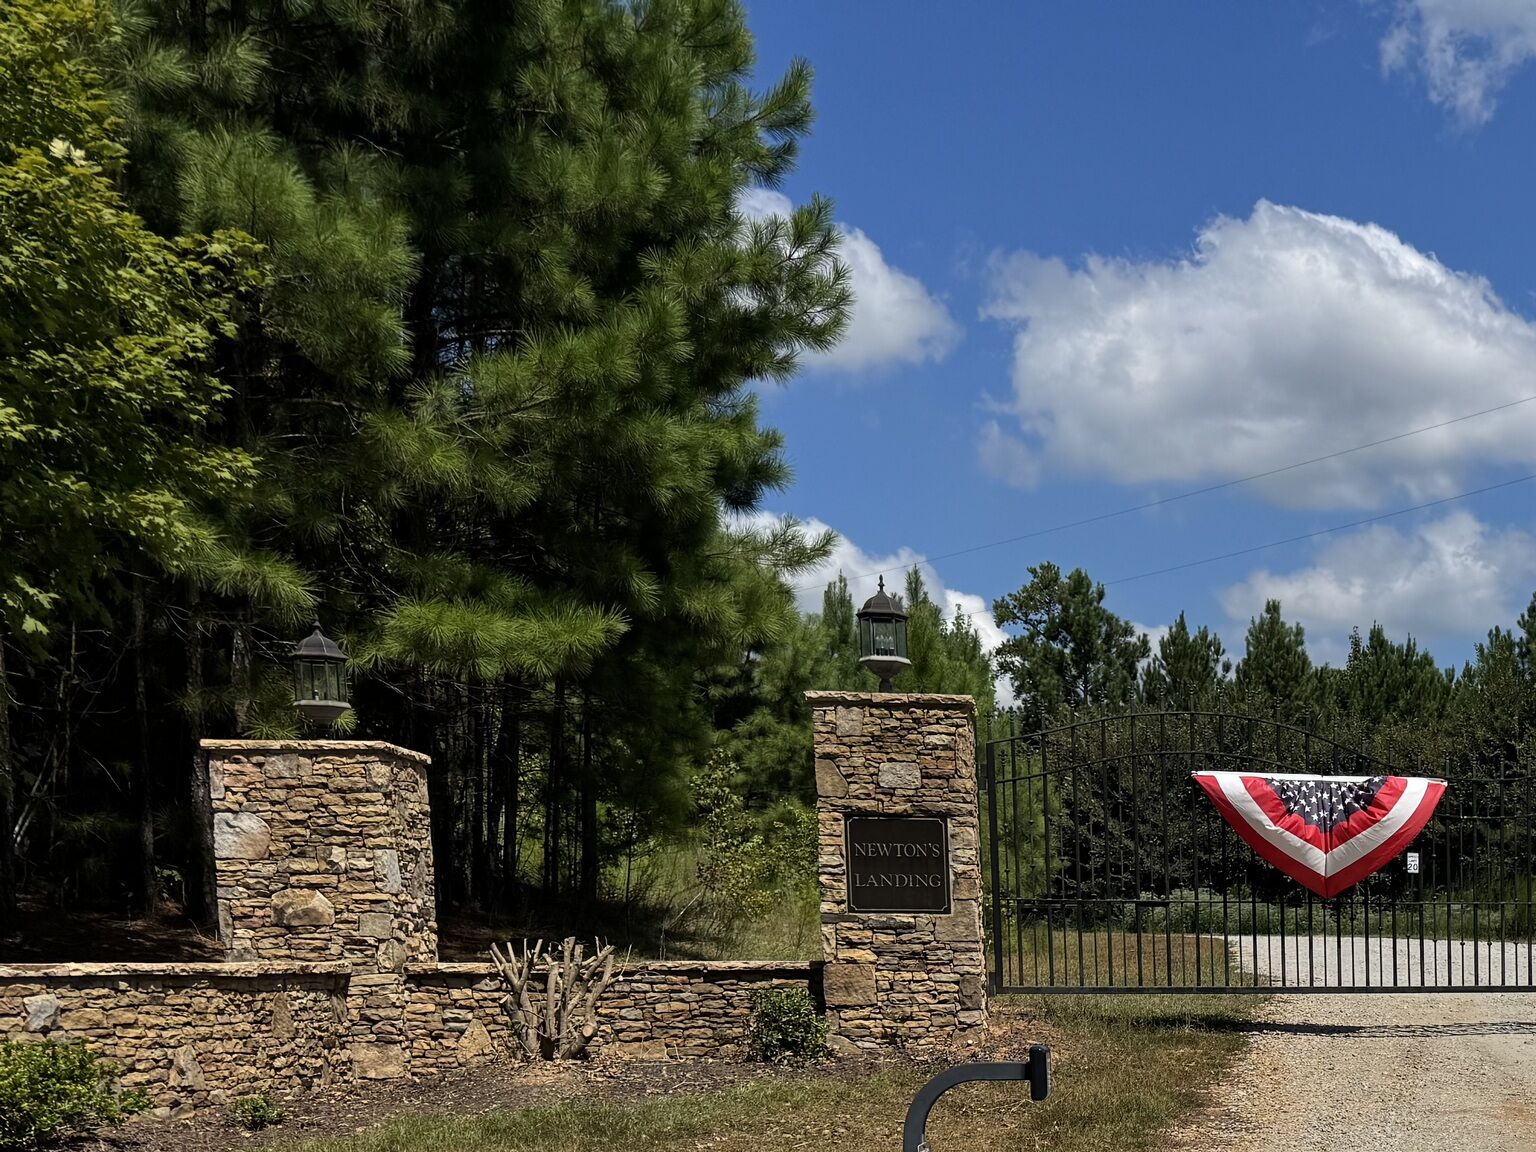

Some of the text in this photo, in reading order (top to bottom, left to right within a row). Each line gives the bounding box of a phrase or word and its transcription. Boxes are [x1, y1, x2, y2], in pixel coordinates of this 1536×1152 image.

[854, 842, 940, 857] NEWTON'S
[1407, 863, 1418, 871] 20
[855, 873, 941, 887] LANDING
